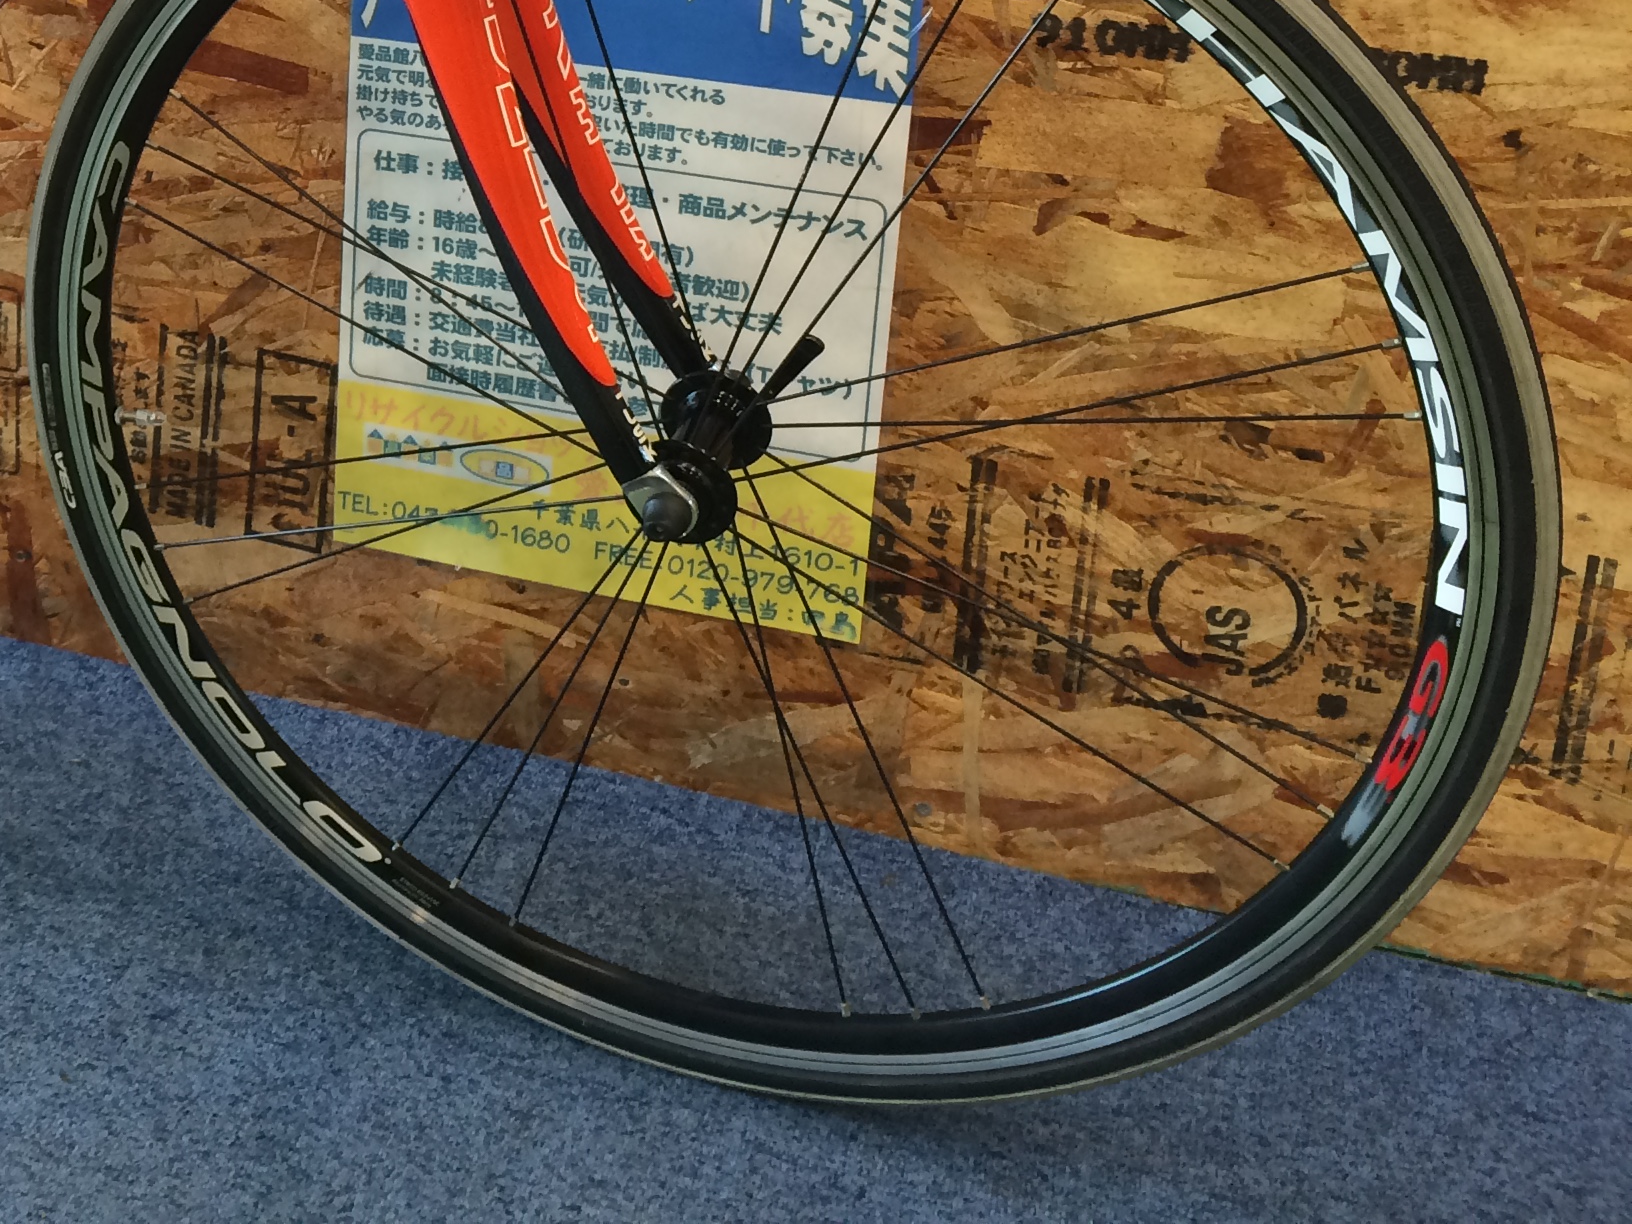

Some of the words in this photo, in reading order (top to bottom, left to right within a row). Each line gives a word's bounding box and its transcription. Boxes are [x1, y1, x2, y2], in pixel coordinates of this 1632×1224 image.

[170, 329, 199, 422] CANADA
[79, 138, 382, 866] CAMPAGNOLO
[1201, 605, 1252, 677] JAS
[1375, 633, 1451, 792] G3
